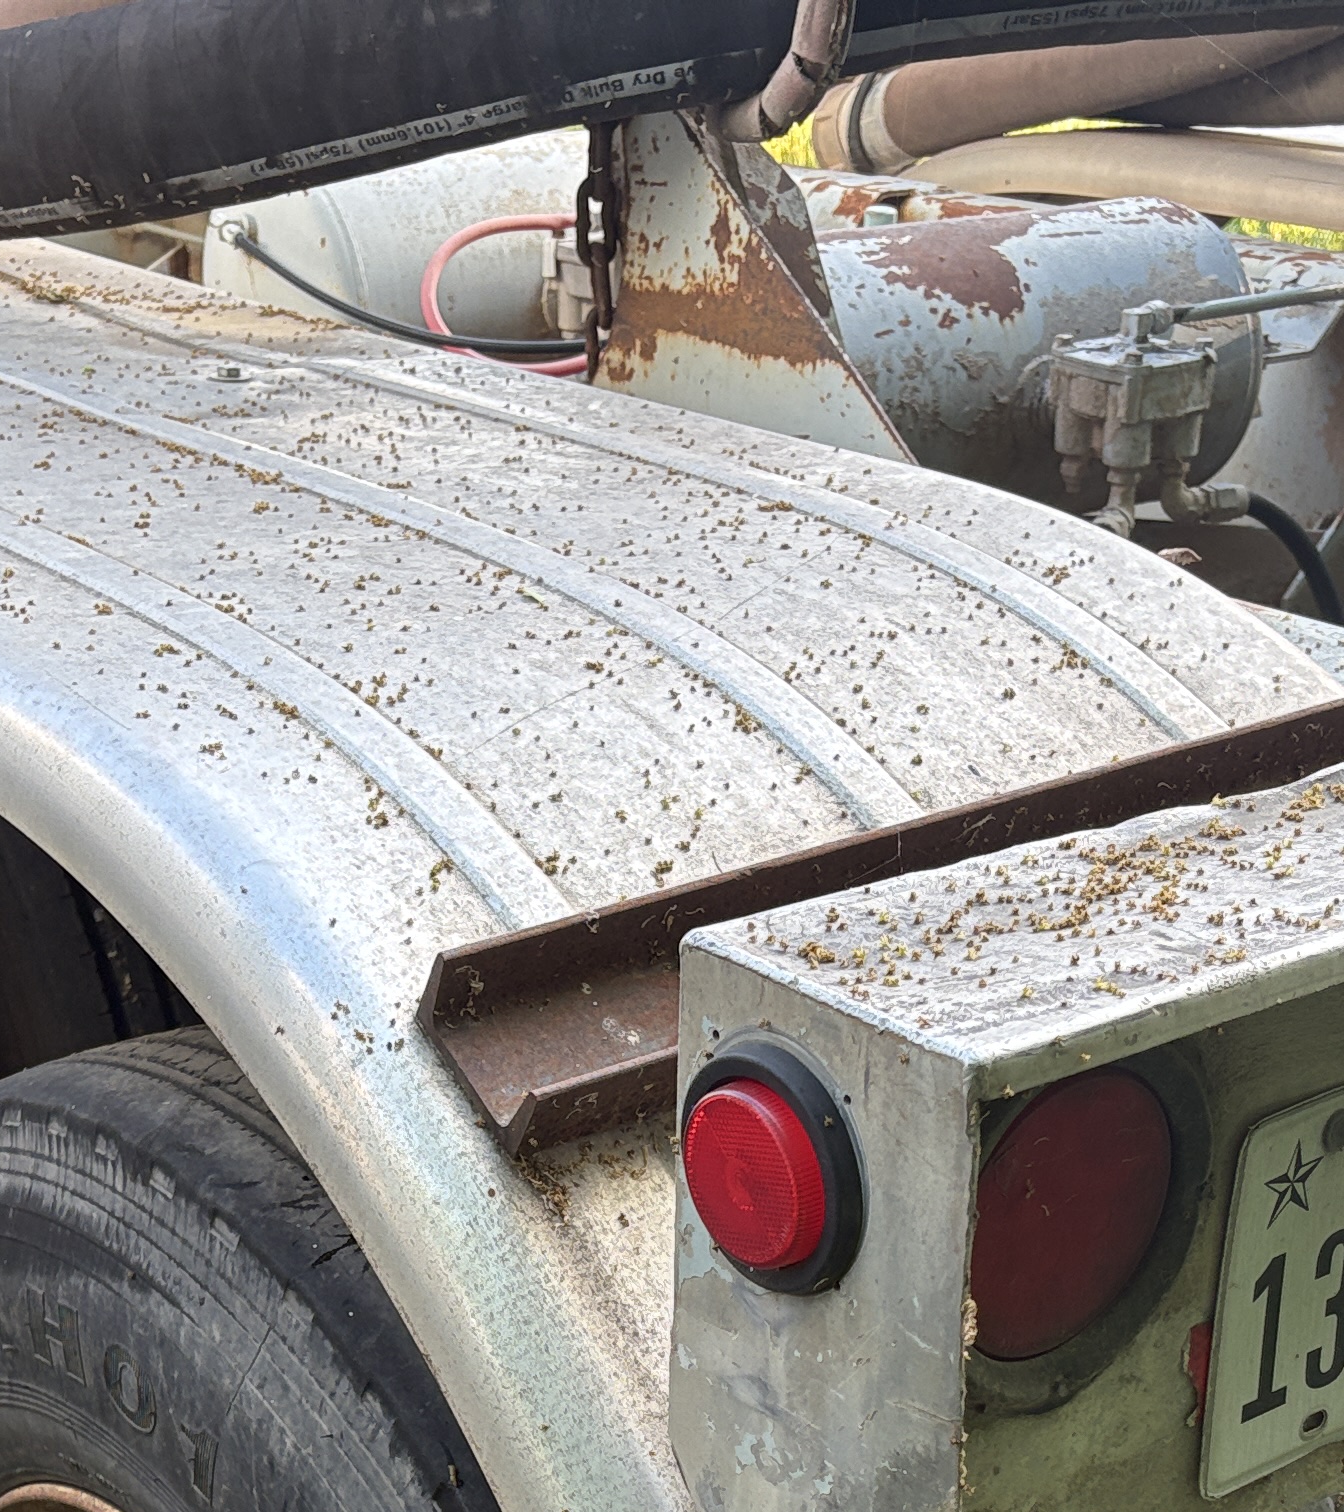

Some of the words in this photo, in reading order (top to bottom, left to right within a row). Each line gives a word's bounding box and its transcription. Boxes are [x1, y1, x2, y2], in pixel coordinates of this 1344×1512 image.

[1061, 5, 1109, 25] 75psi
[579, 78, 624, 104] Bulk
[632, 69, 666, 90] Dry
[357, 118, 453, 152] (101.6mm)
